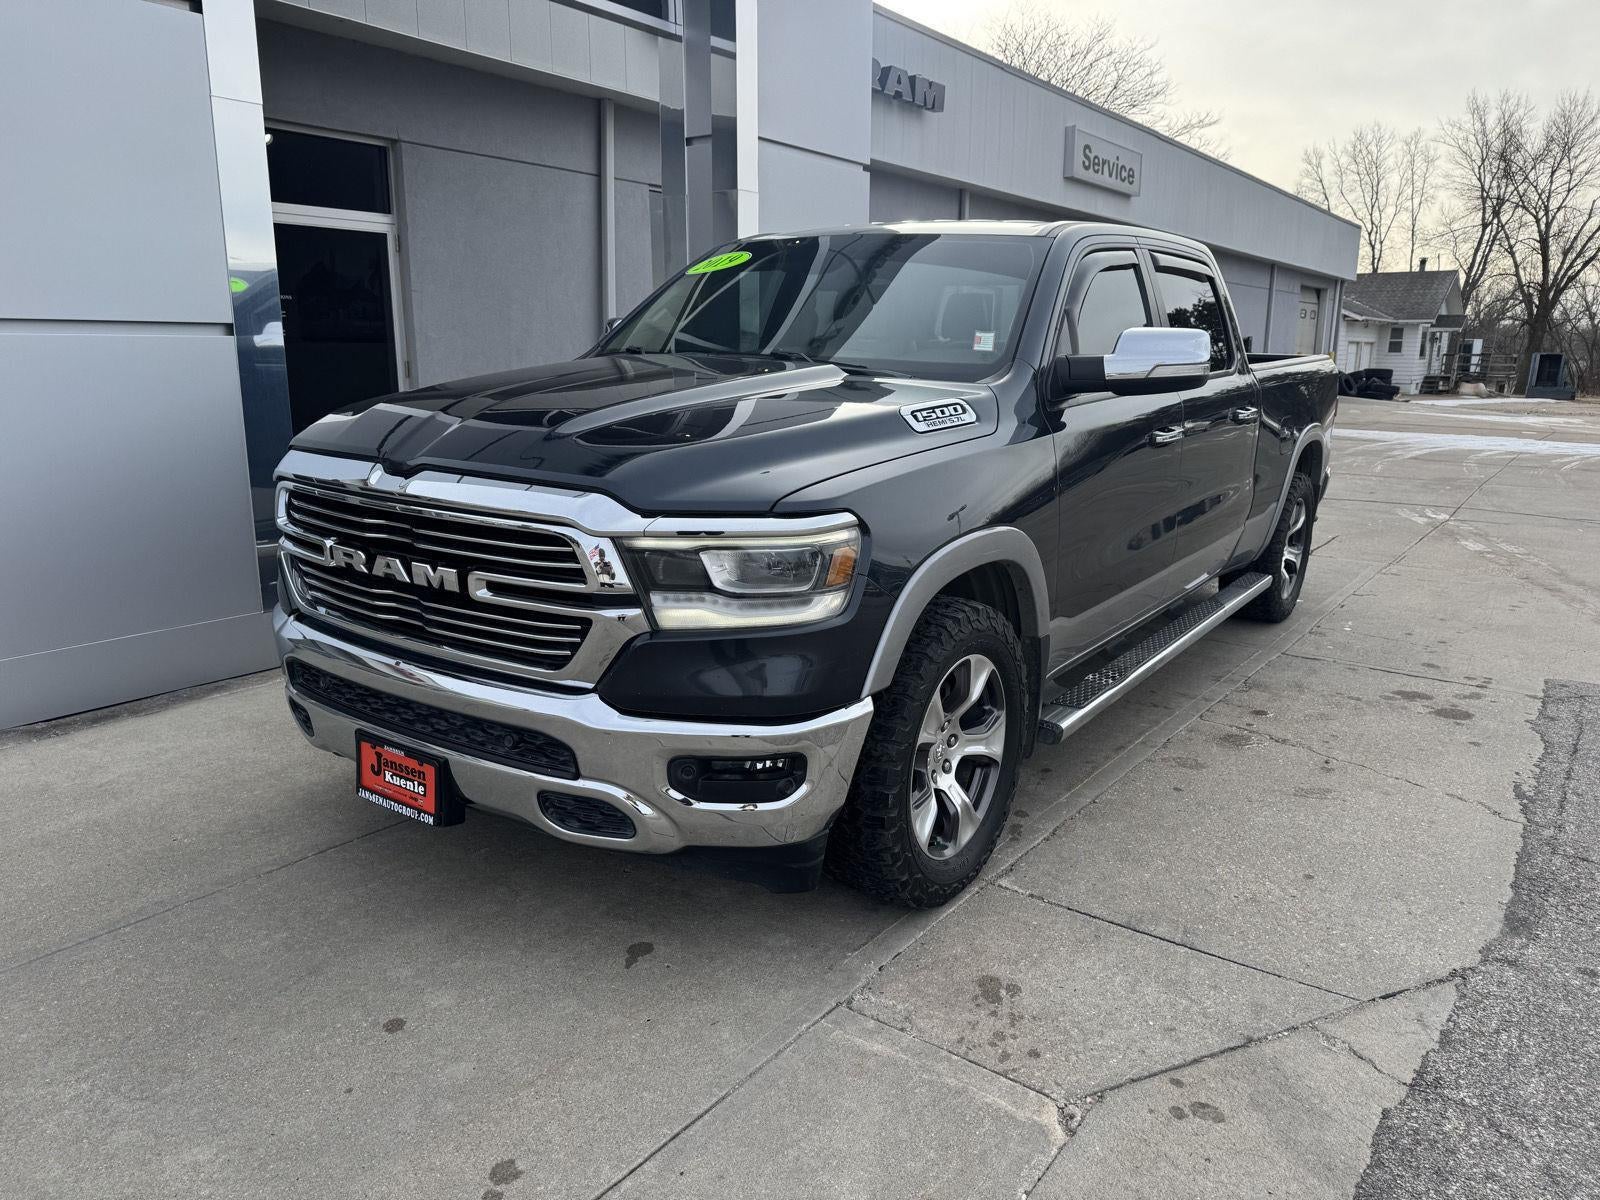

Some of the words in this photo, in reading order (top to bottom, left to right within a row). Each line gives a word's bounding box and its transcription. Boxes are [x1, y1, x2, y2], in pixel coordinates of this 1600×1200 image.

[1082, 144, 1135, 185] Service
[693, 253, 744, 271] 2019
[913, 404, 963, 420] 1500
[926, 418, 947, 428] HEMI
[949, 416, 966, 424] 5.7L
[333, 544, 459, 592] RAM
[370, 751, 426, 781] Janssen
[384, 770, 425, 795] Kuenle
[358, 788, 434, 825] JANSSENAUTOGROUP.COM
